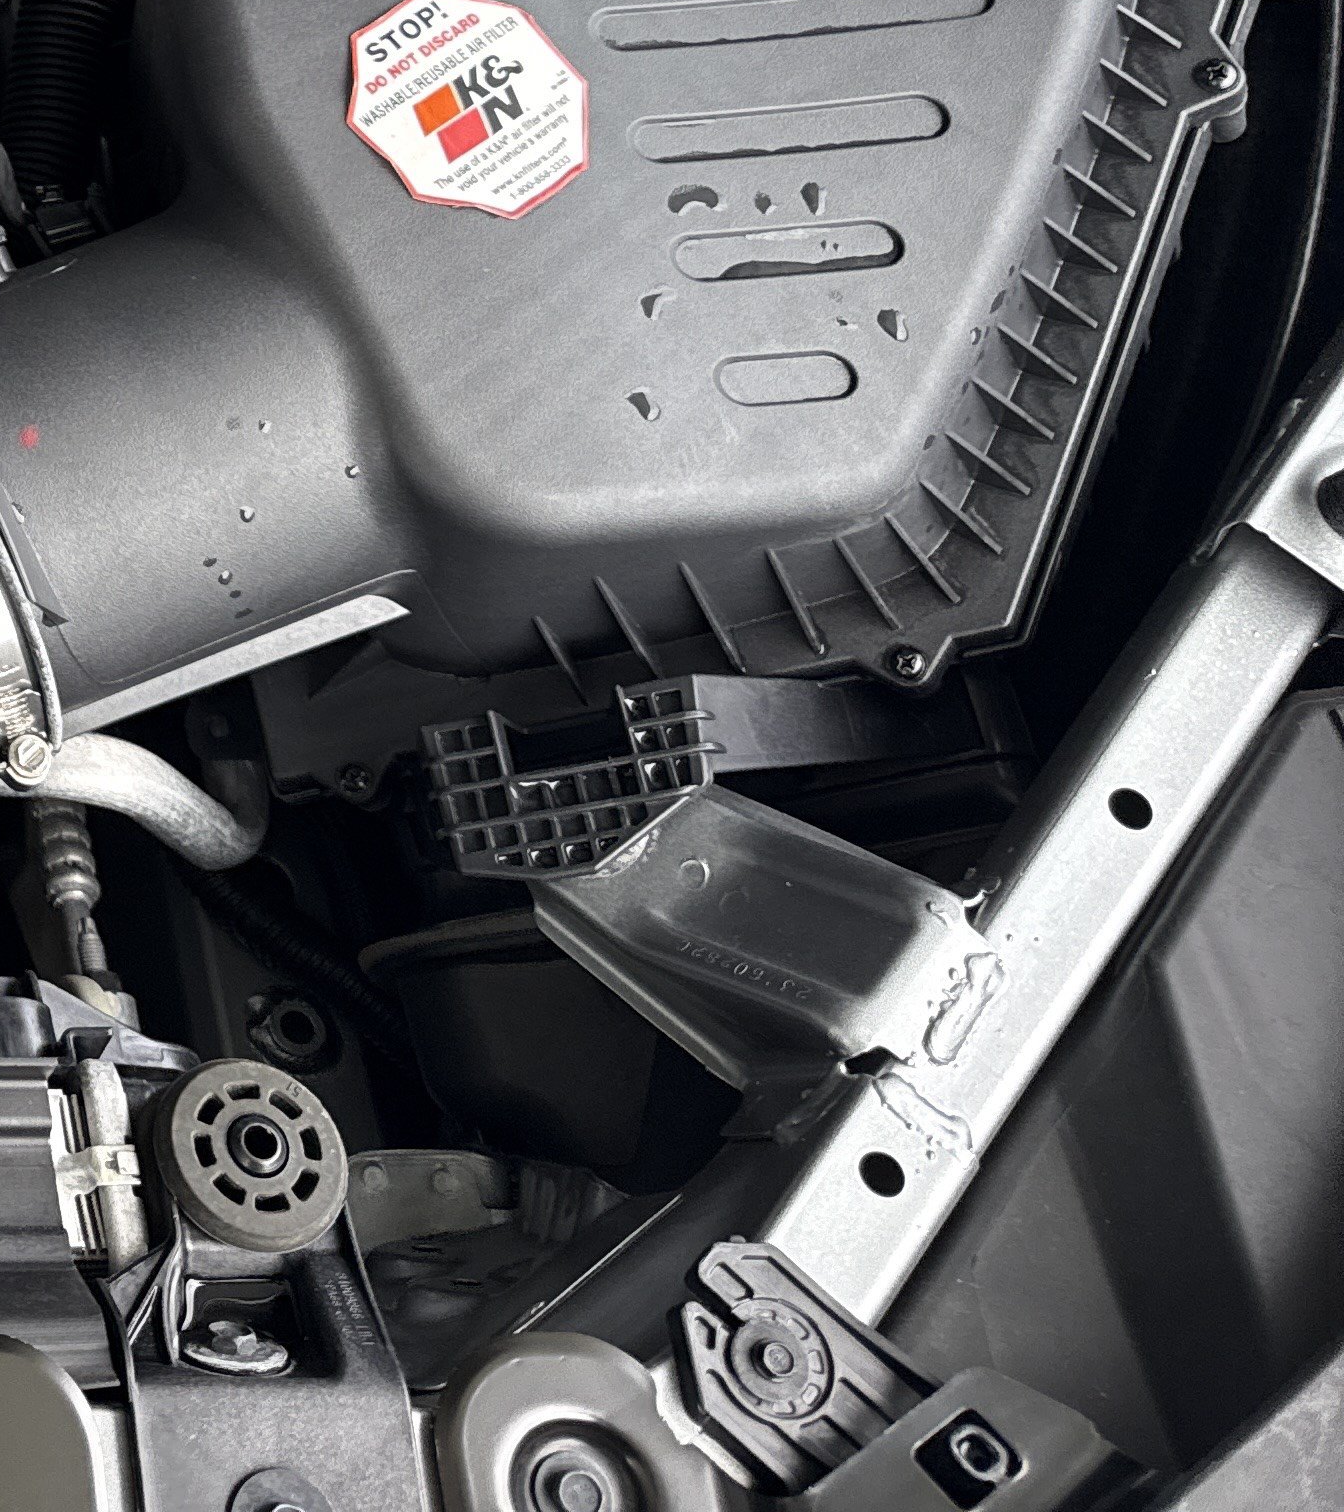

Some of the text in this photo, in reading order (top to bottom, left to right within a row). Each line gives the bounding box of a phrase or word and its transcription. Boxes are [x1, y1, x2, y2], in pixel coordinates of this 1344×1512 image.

[360, 16, 520, 127] WASHABLE/REUSABLE AIR FILTER
[364, 13, 481, 95] DO NOT DISCARD
[365, 0, 449, 63] STOP!
[434, 174, 454, 190] The
[454, 164, 472, 178] use
[470, 155, 481, 167] of
[511, 127, 523, 141] air
[521, 114, 542, 133] filter
[542, 101, 557, 118] will
[555, 94, 571, 108] not
[457, 113, 570, 191] void your vehicle's warranty
